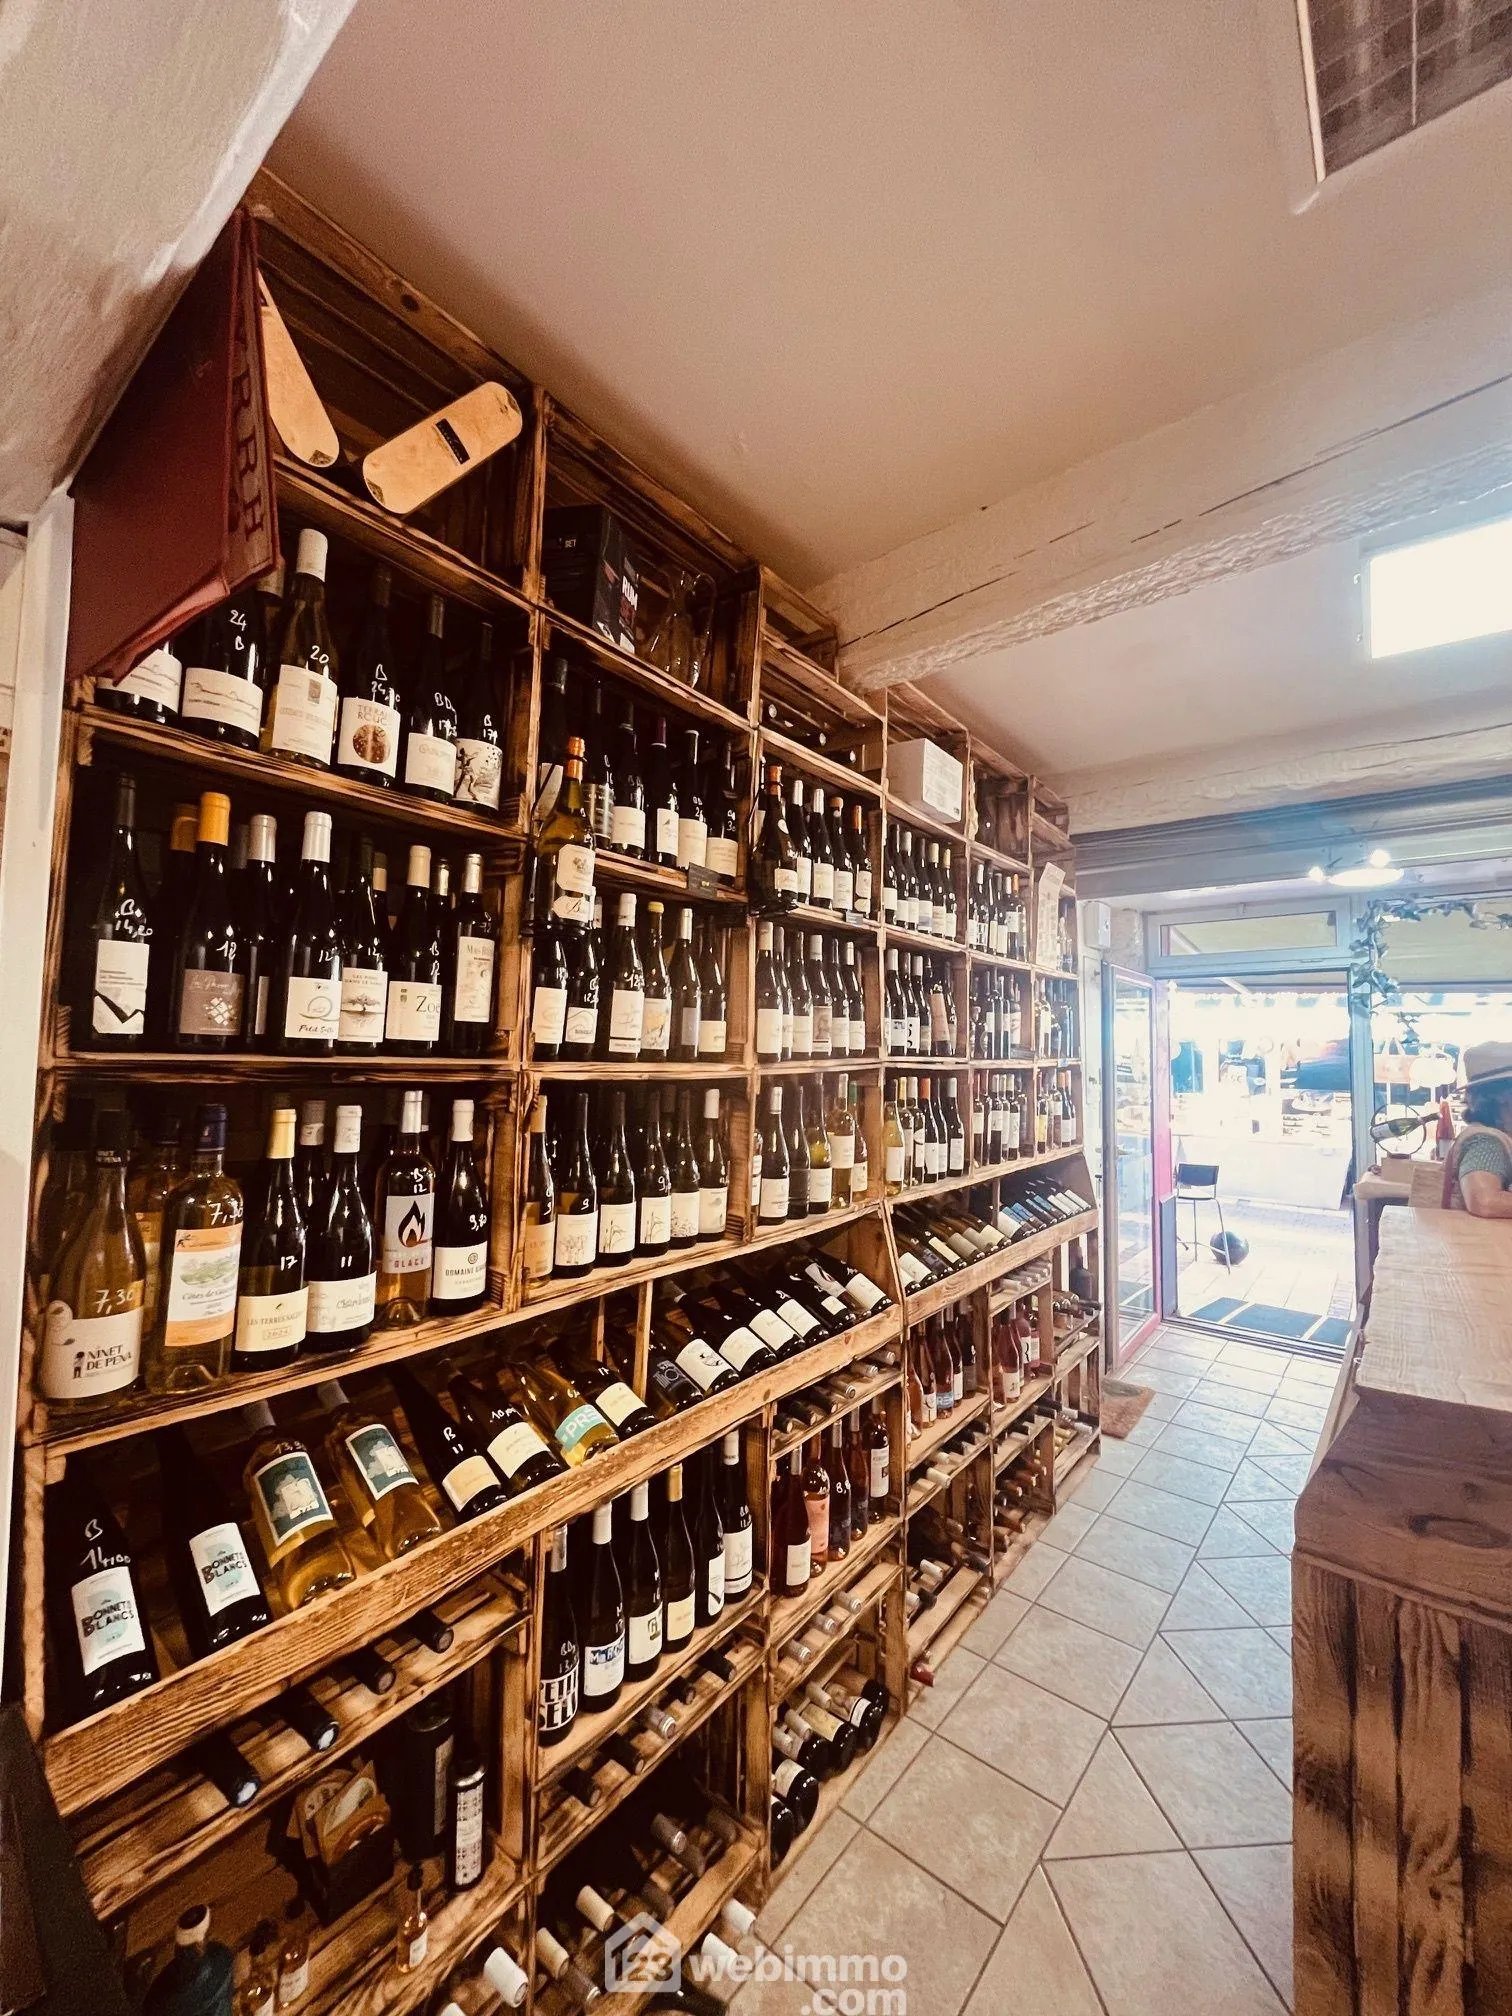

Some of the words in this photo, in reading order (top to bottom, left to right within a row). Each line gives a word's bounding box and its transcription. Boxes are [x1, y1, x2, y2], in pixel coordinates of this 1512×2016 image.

[228, 610, 247, 631] 24
[310, 645, 329, 664] 20
[413, 1183, 428, 1193] 12
[280, 1254, 298, 1271] 17
[95, 1289, 135, 1314] 7,30
[88, 1344, 124, 1359] NINET
[86, 1361, 102, 1371] DE
